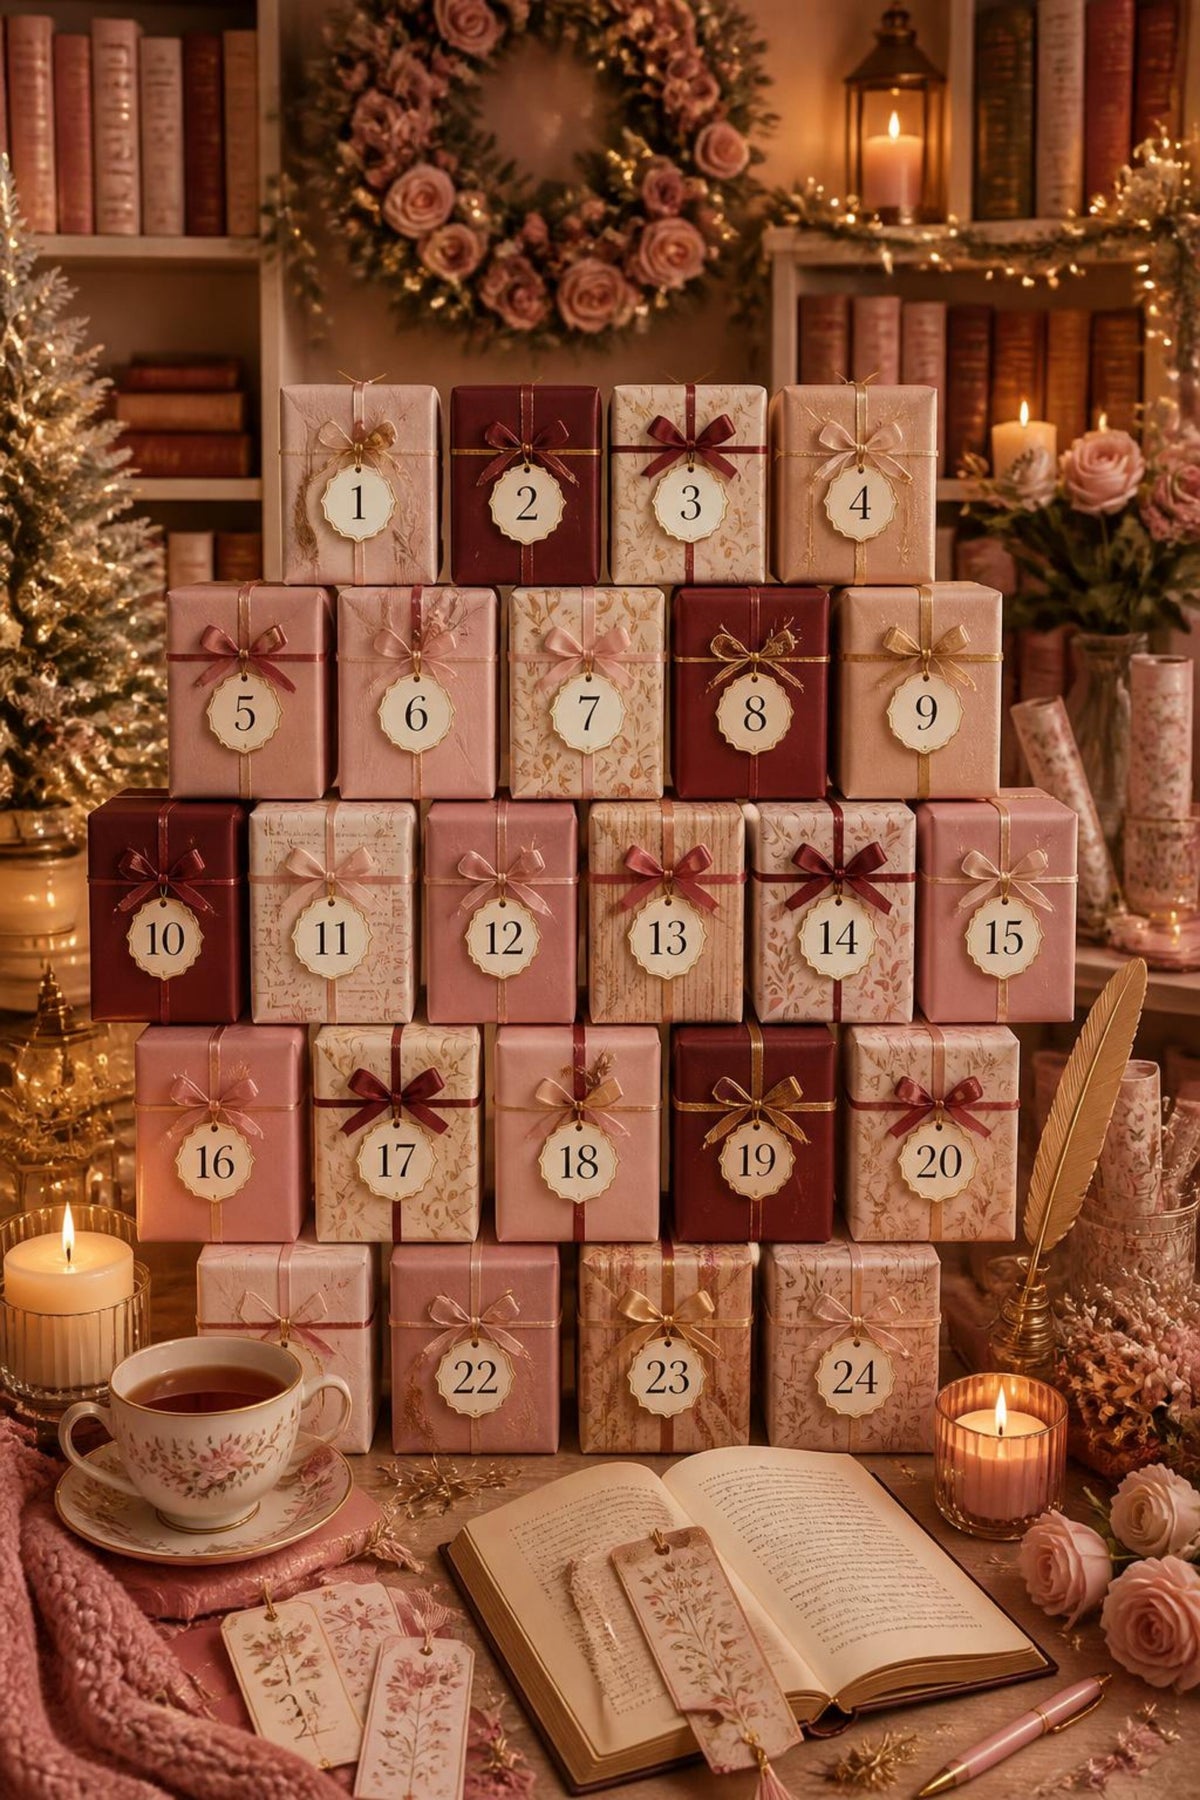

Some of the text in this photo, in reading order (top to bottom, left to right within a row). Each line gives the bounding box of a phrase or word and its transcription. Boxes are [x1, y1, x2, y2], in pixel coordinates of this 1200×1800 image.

[351, 484, 366, 520] 1
[515, 485, 538, 521] 2
[680, 484, 702, 521] 3
[848, 485, 872, 520] 4
[234, 695, 256, 732] 5
[404, 695, 428, 732] 6
[578, 695, 601, 732] 7
[743, 695, 767, 732] 8
[915, 694, 938, 731] 9
[145, 921, 185, 956] 10
[315, 921, 349, 956] 11
[485, 920, 524, 955] 12
[648, 920, 687, 956] 13
[819, 919, 859, 955] 14
[985, 919, 1024, 956] 15
[196, 1144, 235, 1180] 16
[377, 1143, 417, 1178] 17
[560, 1144, 599, 1180] 18
[738, 1143, 776, 1177] 19
[916, 1144, 963, 1179] 20
[452, 1360, 498, 1395] 22
[645, 1359, 690, 1395] 23
[832, 1359, 879, 1395] 24
